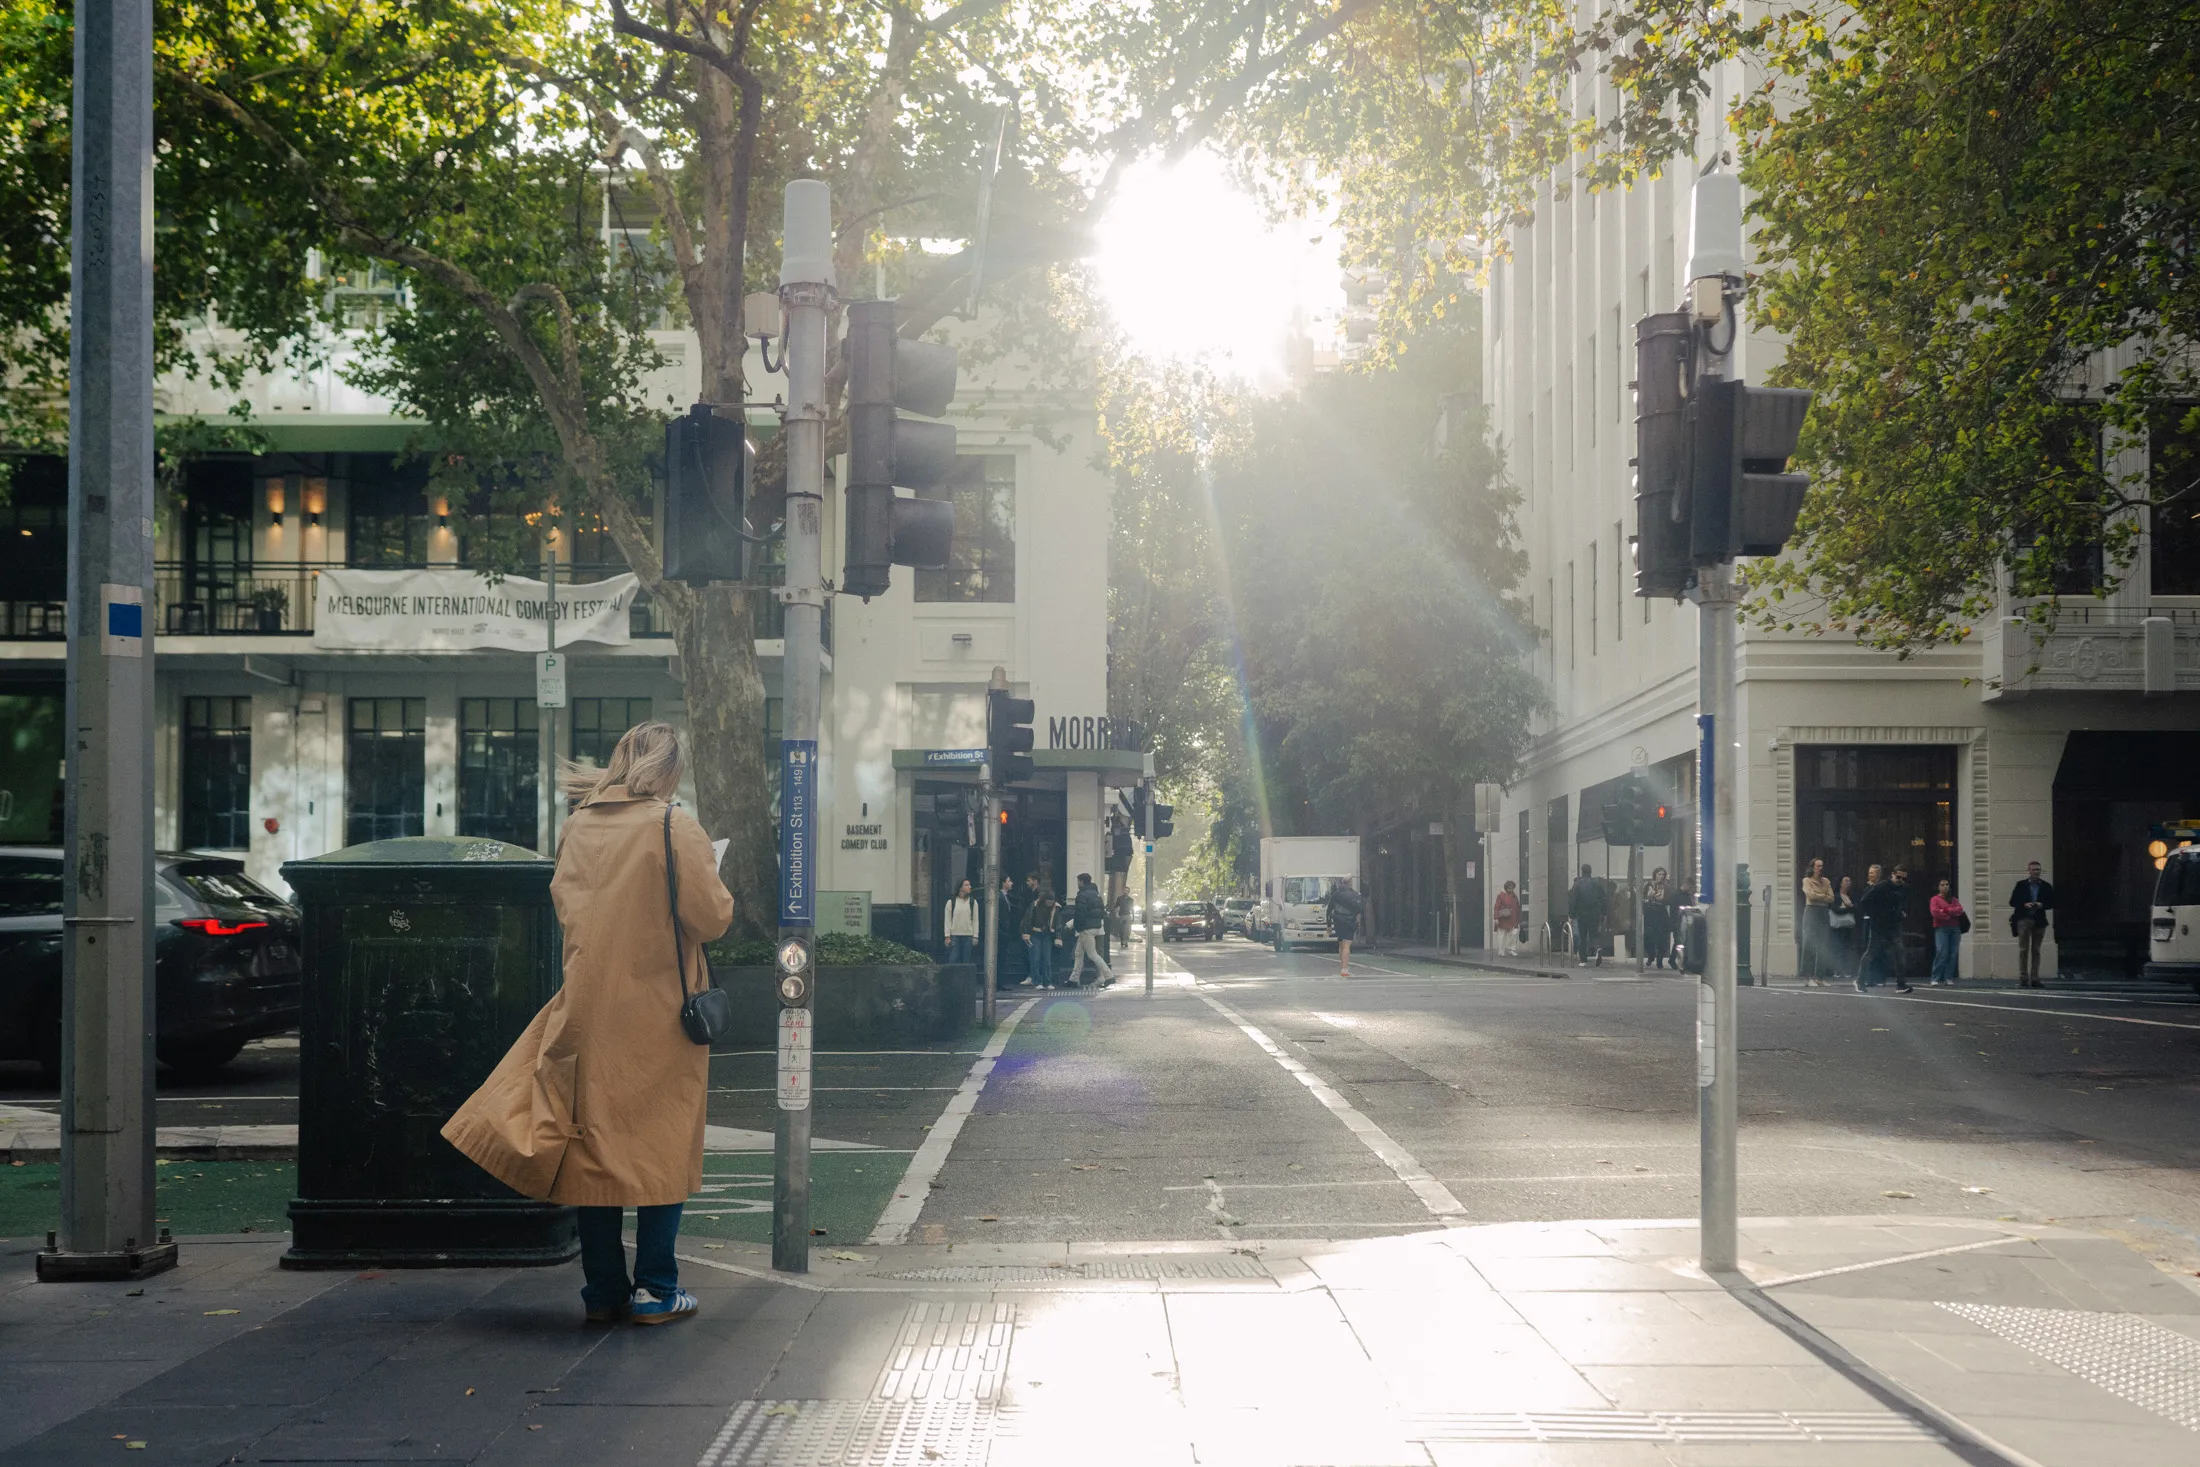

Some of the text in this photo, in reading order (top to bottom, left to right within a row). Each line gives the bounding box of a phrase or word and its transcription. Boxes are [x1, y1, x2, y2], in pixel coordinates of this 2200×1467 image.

[328, 595, 409, 615] MELBOURNE
[412, 596, 511, 617] INTERNATIONAL
[545, 658, 556, 671] P
[1049, 715, 1120, 750] MORR
[933, 751, 973, 761] Exhibition
[974, 750, 984, 759] St
[793, 769, 803, 786] 149
[794, 795, 803, 812] 113
[790, 813, 803, 828] St
[846, 824, 882, 835] BASEMENT
[841, 839, 888, 850] COMEDY CLUB
[790, 832, 803, 898] Exhibition
